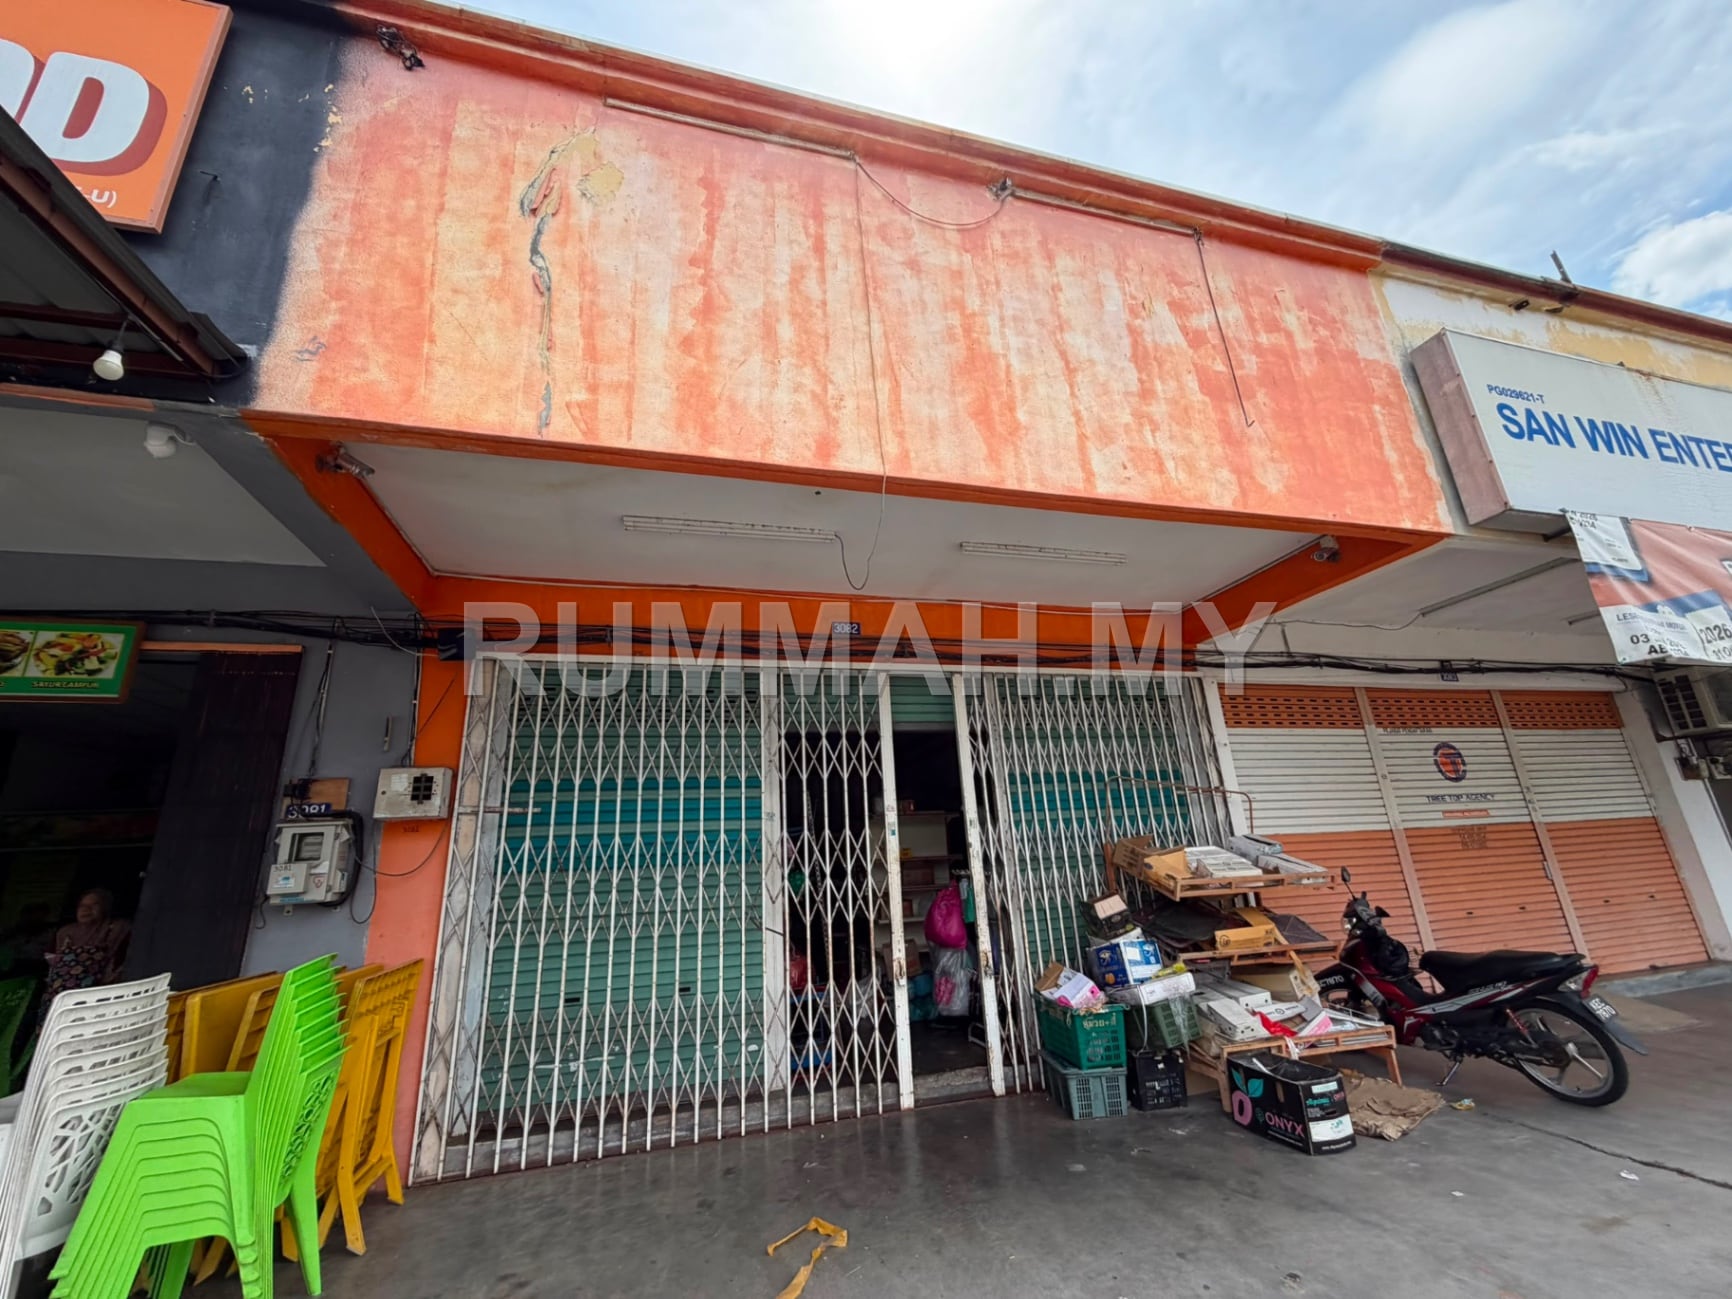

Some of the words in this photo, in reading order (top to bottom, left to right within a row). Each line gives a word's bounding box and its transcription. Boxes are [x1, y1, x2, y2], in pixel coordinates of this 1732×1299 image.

[1496, 402, 1576, 449] SAN
[1573, 415, 1649, 460] WIN
[833, 623, 858, 634] 3082
[1630, 633, 1650, 645] 03
[1264, 1111, 1305, 1138] ONYX
